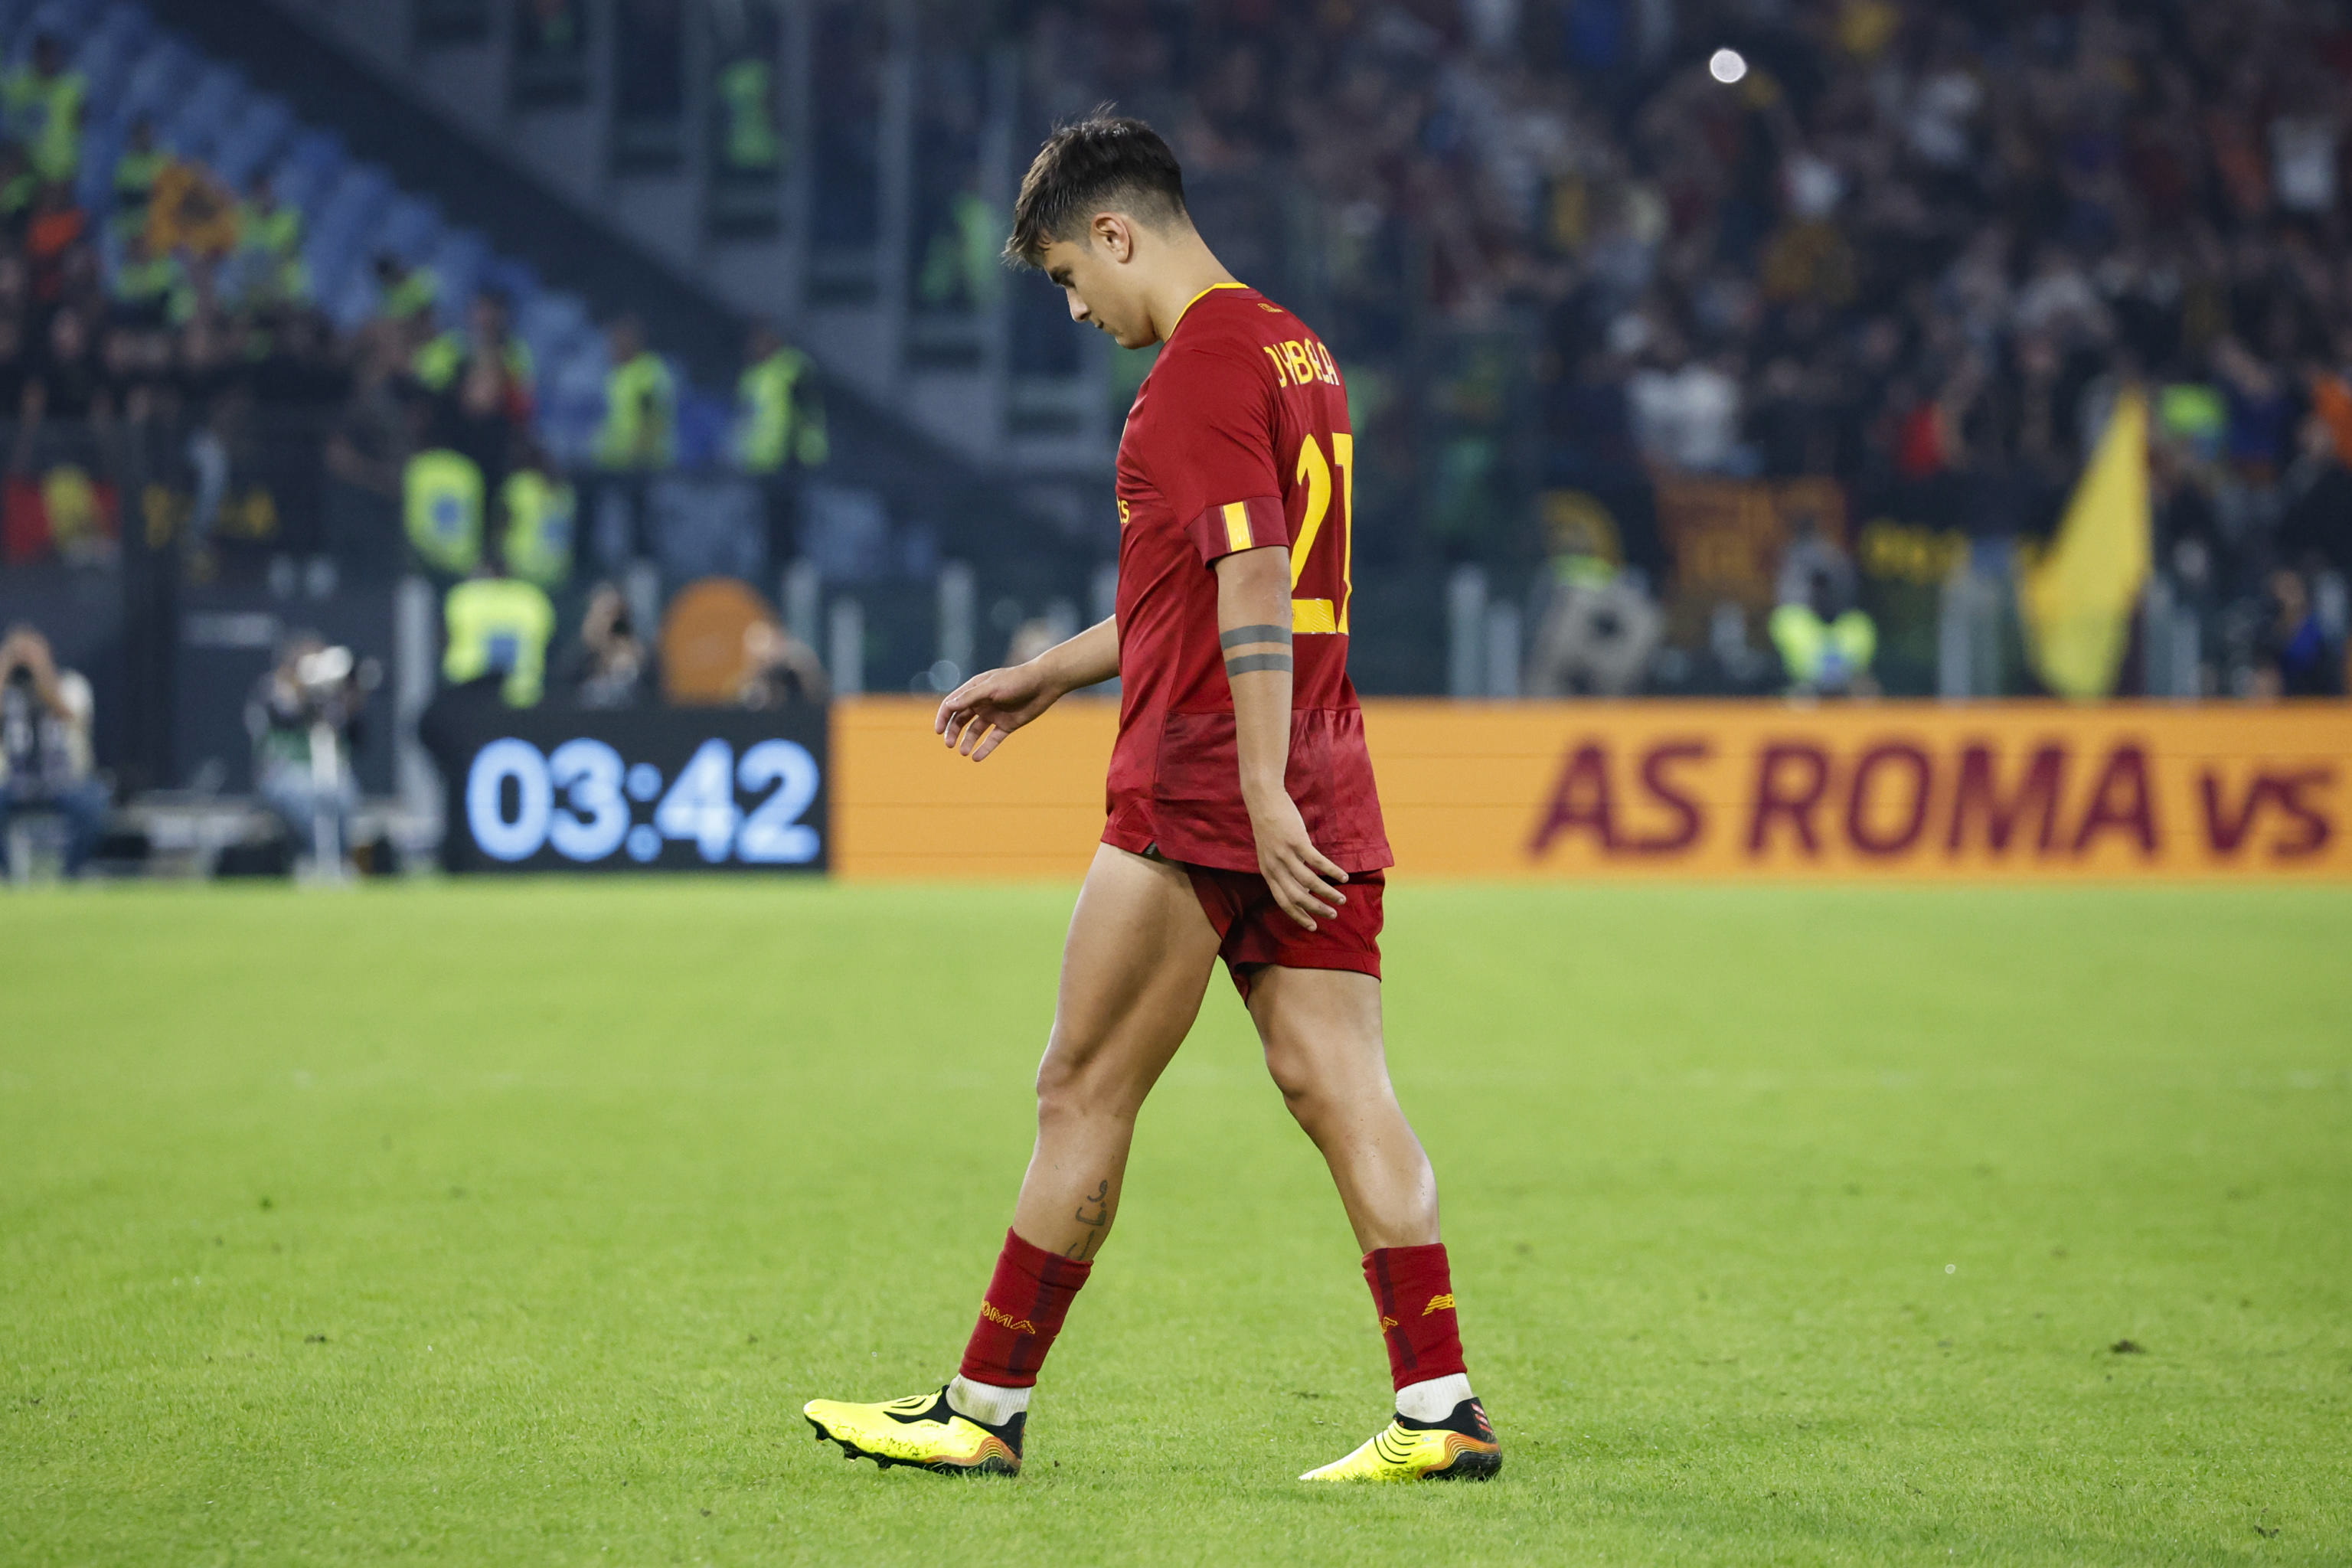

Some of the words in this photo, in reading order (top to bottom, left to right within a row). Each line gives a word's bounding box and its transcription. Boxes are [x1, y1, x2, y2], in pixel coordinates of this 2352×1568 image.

[1290, 433, 1353, 636] 21
[466, 737, 821, 864] 03:42
[1525, 738, 1713, 861] AS
[1744, 738, 2161, 861] ROMA
[981, 1299, 1036, 1334] OMA
